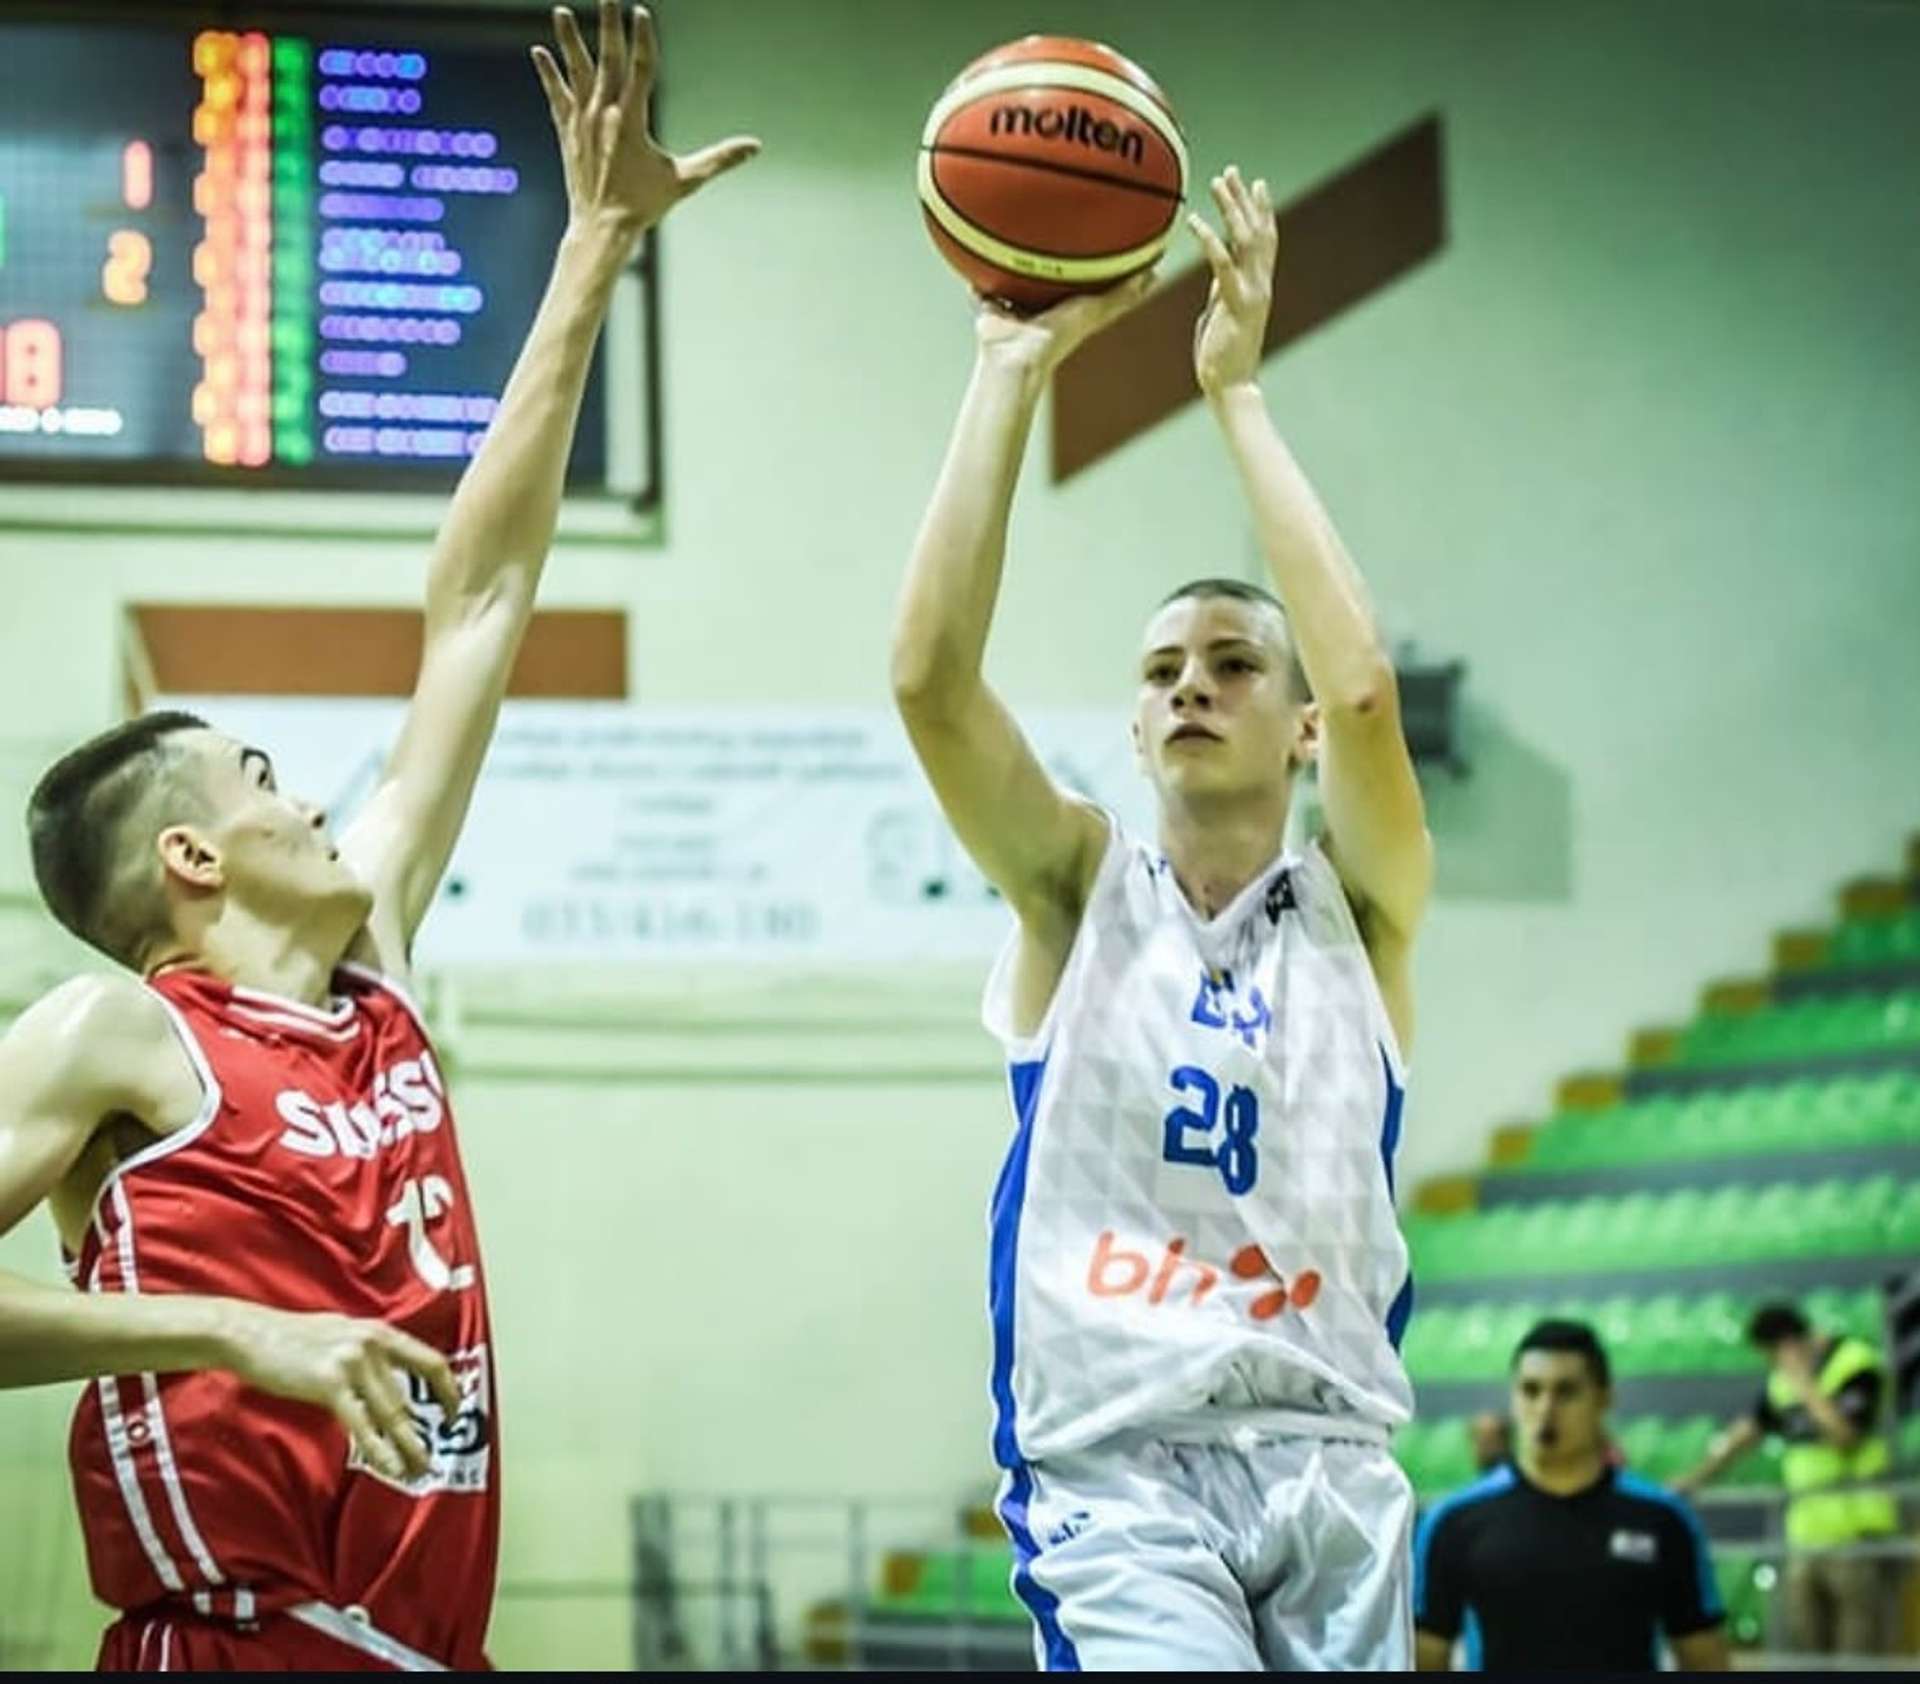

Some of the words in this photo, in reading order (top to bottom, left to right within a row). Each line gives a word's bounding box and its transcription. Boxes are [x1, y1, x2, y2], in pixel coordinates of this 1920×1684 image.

[990, 106, 1145, 165] molten
[1163, 1066, 1258, 1196] 28
[386, 1175, 475, 1293] 12
